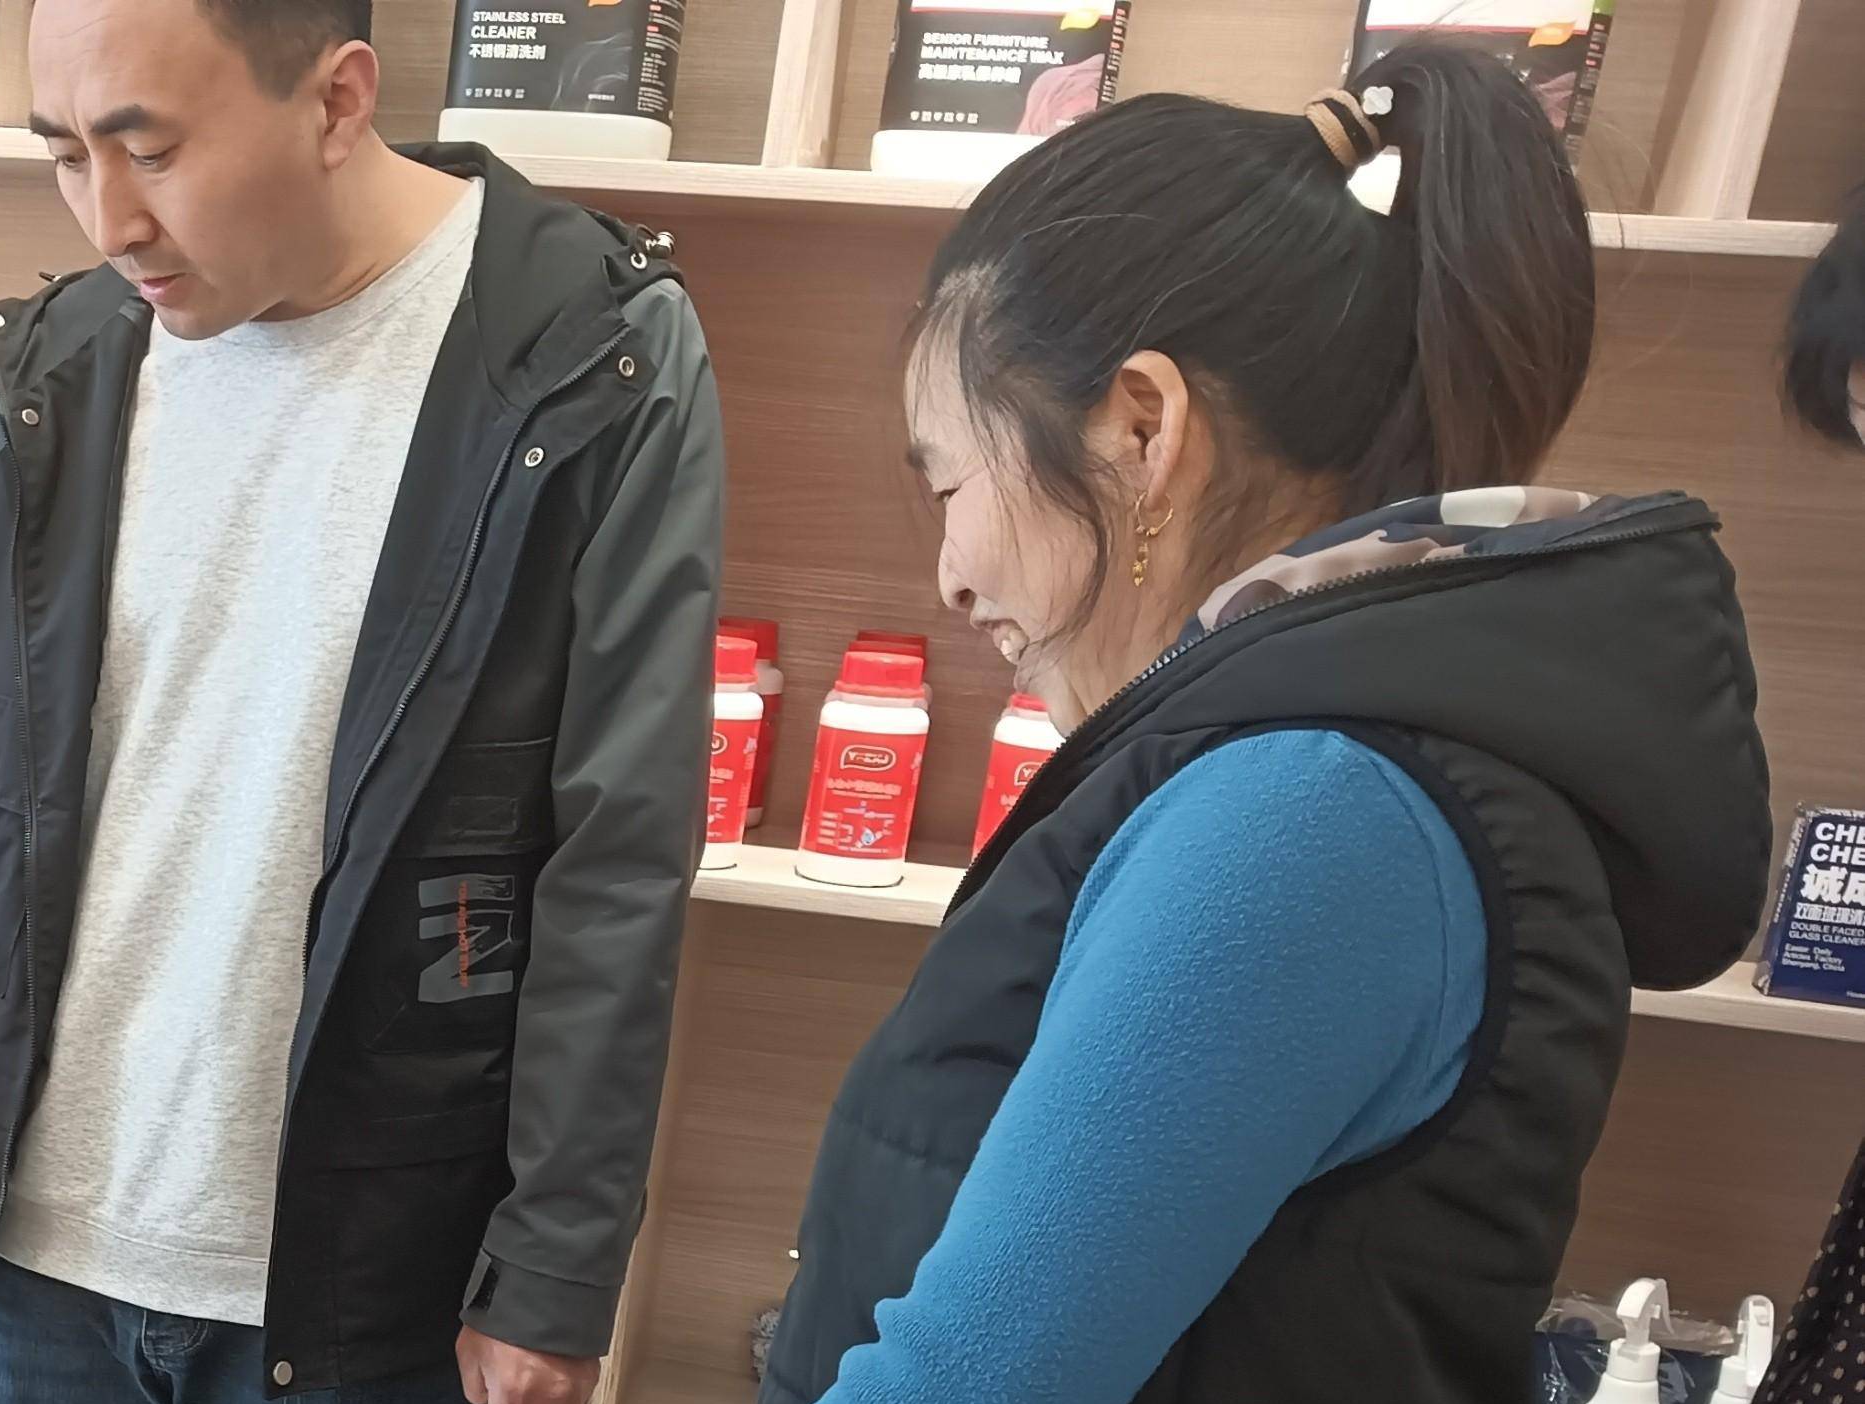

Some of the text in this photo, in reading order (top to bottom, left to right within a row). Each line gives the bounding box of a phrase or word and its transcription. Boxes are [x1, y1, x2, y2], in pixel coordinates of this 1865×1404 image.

[472, 11, 566, 24] STAINLESS STEEL
[471, 25, 537, 39] CLEANER
[923, 32, 1049, 49] SENIOR FURNITURE
[920, 45, 1064, 65] MAINTENANCE WAX
[1794, 902, 1865, 926] 双面玻璃清
[1789, 930, 1820, 941] GLASS
[1791, 921, 1865, 937] DOUBLE FACED
